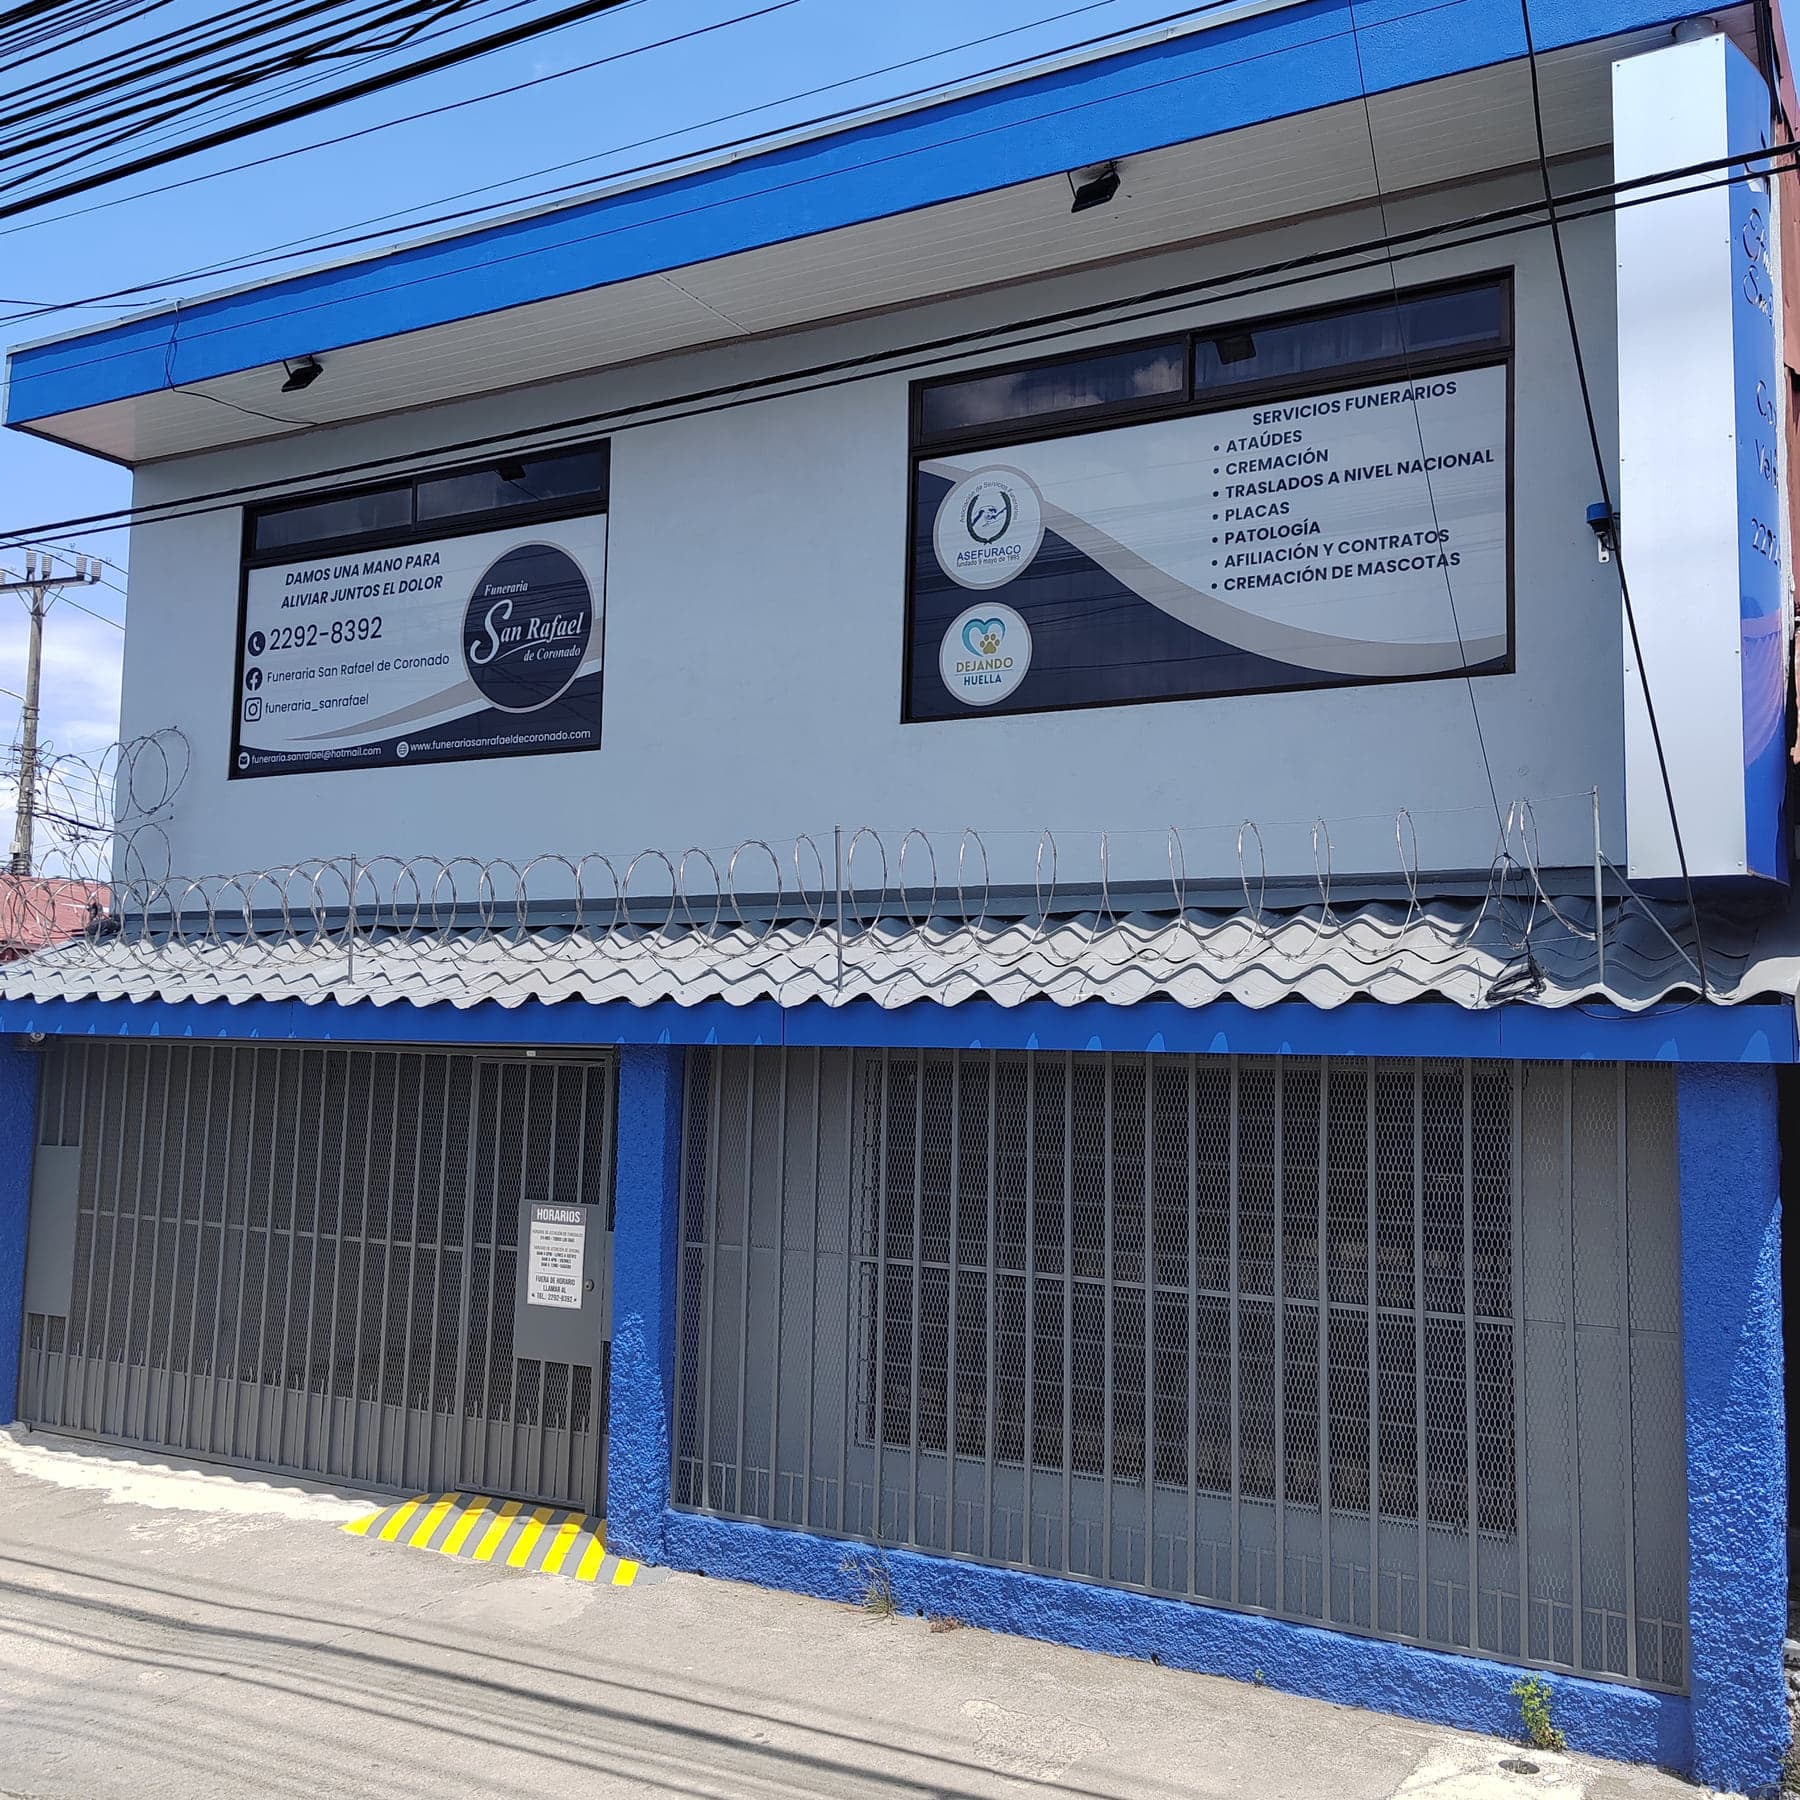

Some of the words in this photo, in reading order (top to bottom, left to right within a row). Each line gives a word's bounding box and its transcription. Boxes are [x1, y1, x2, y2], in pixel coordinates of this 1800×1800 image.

[1252, 399, 1341, 426] SERVICIOS
[1345, 380, 1457, 412] FUNERARIOS
[1226, 430, 1303, 453] ATAÚDES
[1225, 447, 1329, 476] CREMACIÓN
[1225, 472, 1324, 499] TRASLADOS
[1327, 471, 1340, 485] A
[1344, 462, 1393, 483] NIVEL
[1397, 449, 1495, 477] NACIONAL
[1225, 501, 1290, 522] PLACAS
[1224, 518, 1321, 545] PATOLOGÍA
[957, 544, 1022, 561] ASEFURACO
[1224, 543, 1319, 569] AFILIACIÓN
[1323, 542, 1334, 556] Y
[1337, 528, 1450, 554] CONTRATOS
[285, 567, 331, 586] DAMOS
[333, 562, 360, 580] UNA
[362, 556, 403, 576] MANO
[405, 551, 441, 570] PARA
[1223, 566, 1327, 591] CREMACIÓN
[1331, 564, 1353, 580] DE
[1357, 551, 1461, 577] MASCOTAS
[281, 590, 328, 609] ALIVIAR
[330, 583, 380, 603] JUNTOS
[382, 581, 397, 597] EL
[398, 575, 444, 594] DOLOR
[484, 580, 529, 597] Funeraria
[269, 616, 383, 651] 2292-8392
[469, 599, 522, 665] San
[525, 611, 584, 643] Rafael
[523, 648, 535, 662] de
[536, 645, 581, 662] Coronado
[956, 656, 1014, 673] DEJANDO
[266, 667, 316, 683] Funeraria
[318, 664, 338, 679] San
[340, 660, 375, 677] Rafael
[377, 658, 392, 673] de
[394, 653, 450, 671] Coronado
[963, 673, 1002, 687] HUELLA
[265, 694, 369, 715] funeraria_sanrafael
[410, 729, 591, 752] www.funerariasanrafaeldecoronado.com
[536, 1208, 581, 1223] HORARIOS
[535, 1274, 549, 1283] FUERA
[550, 1276, 556, 1284] DE
